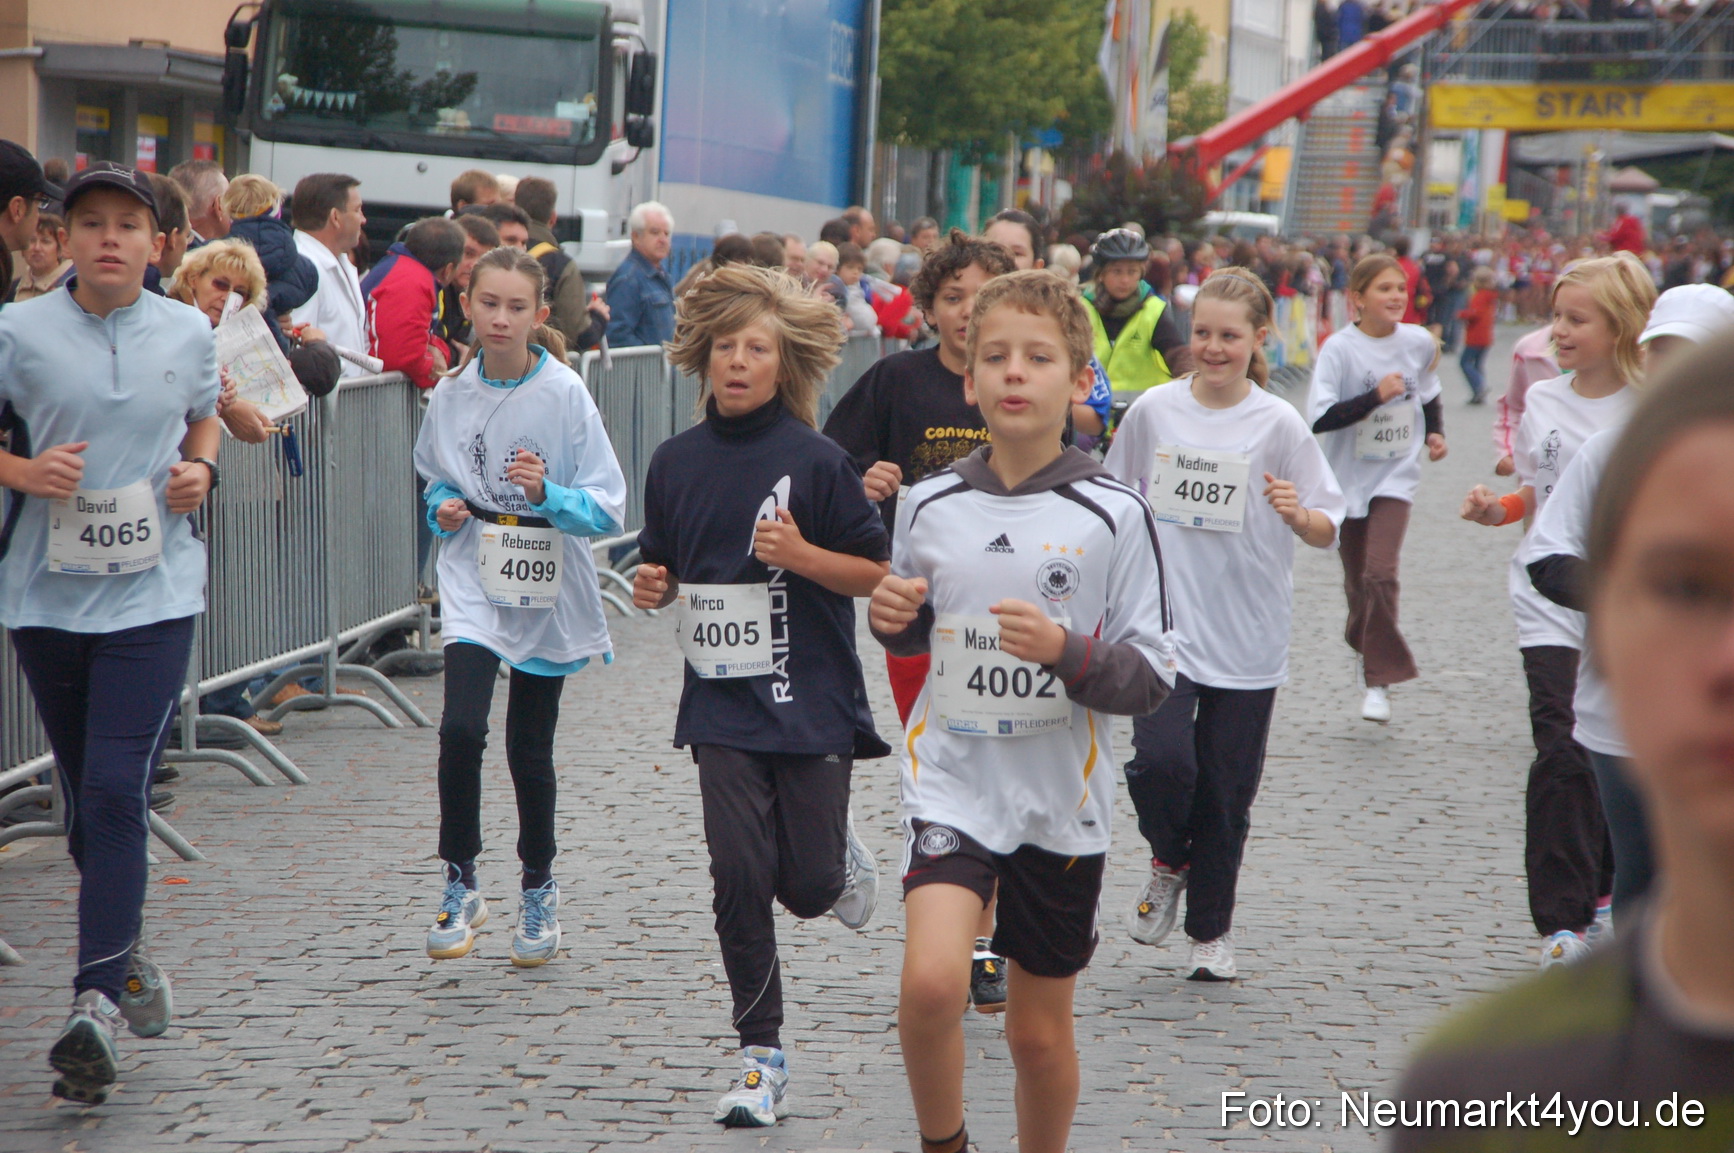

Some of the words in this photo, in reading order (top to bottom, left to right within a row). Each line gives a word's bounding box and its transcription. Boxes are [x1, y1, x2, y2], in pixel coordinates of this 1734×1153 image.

[1537, 91, 1646, 118] START
[1374, 425, 1410, 442] 4018
[503, 466, 549, 475] 28
[1177, 454, 1218, 473] Nadine
[492, 493, 525, 503] Neuma
[1154, 474, 1160, 484] J
[1174, 479, 1237, 505] 4087
[76, 496, 117, 514] David
[53, 518, 60, 529] J
[80, 518, 151, 547] 4065
[502, 533, 551, 551] Rebecca
[985, 546, 1015, 554] adidas
[481, 555, 486, 566] J
[500, 558, 556, 582] 4099
[690, 593, 724, 611] Mirco
[693, 621, 760, 647] 4005
[766, 565, 794, 703] RAIL.ON
[728, 661, 771, 672] PFLEIDERER
[937, 660, 944, 676] J
[967, 665, 1057, 698] 4002
[1014, 716, 1069, 729] PFLEIDERER
[127, 978, 141, 992] S
[747, 1072, 760, 1085] S
